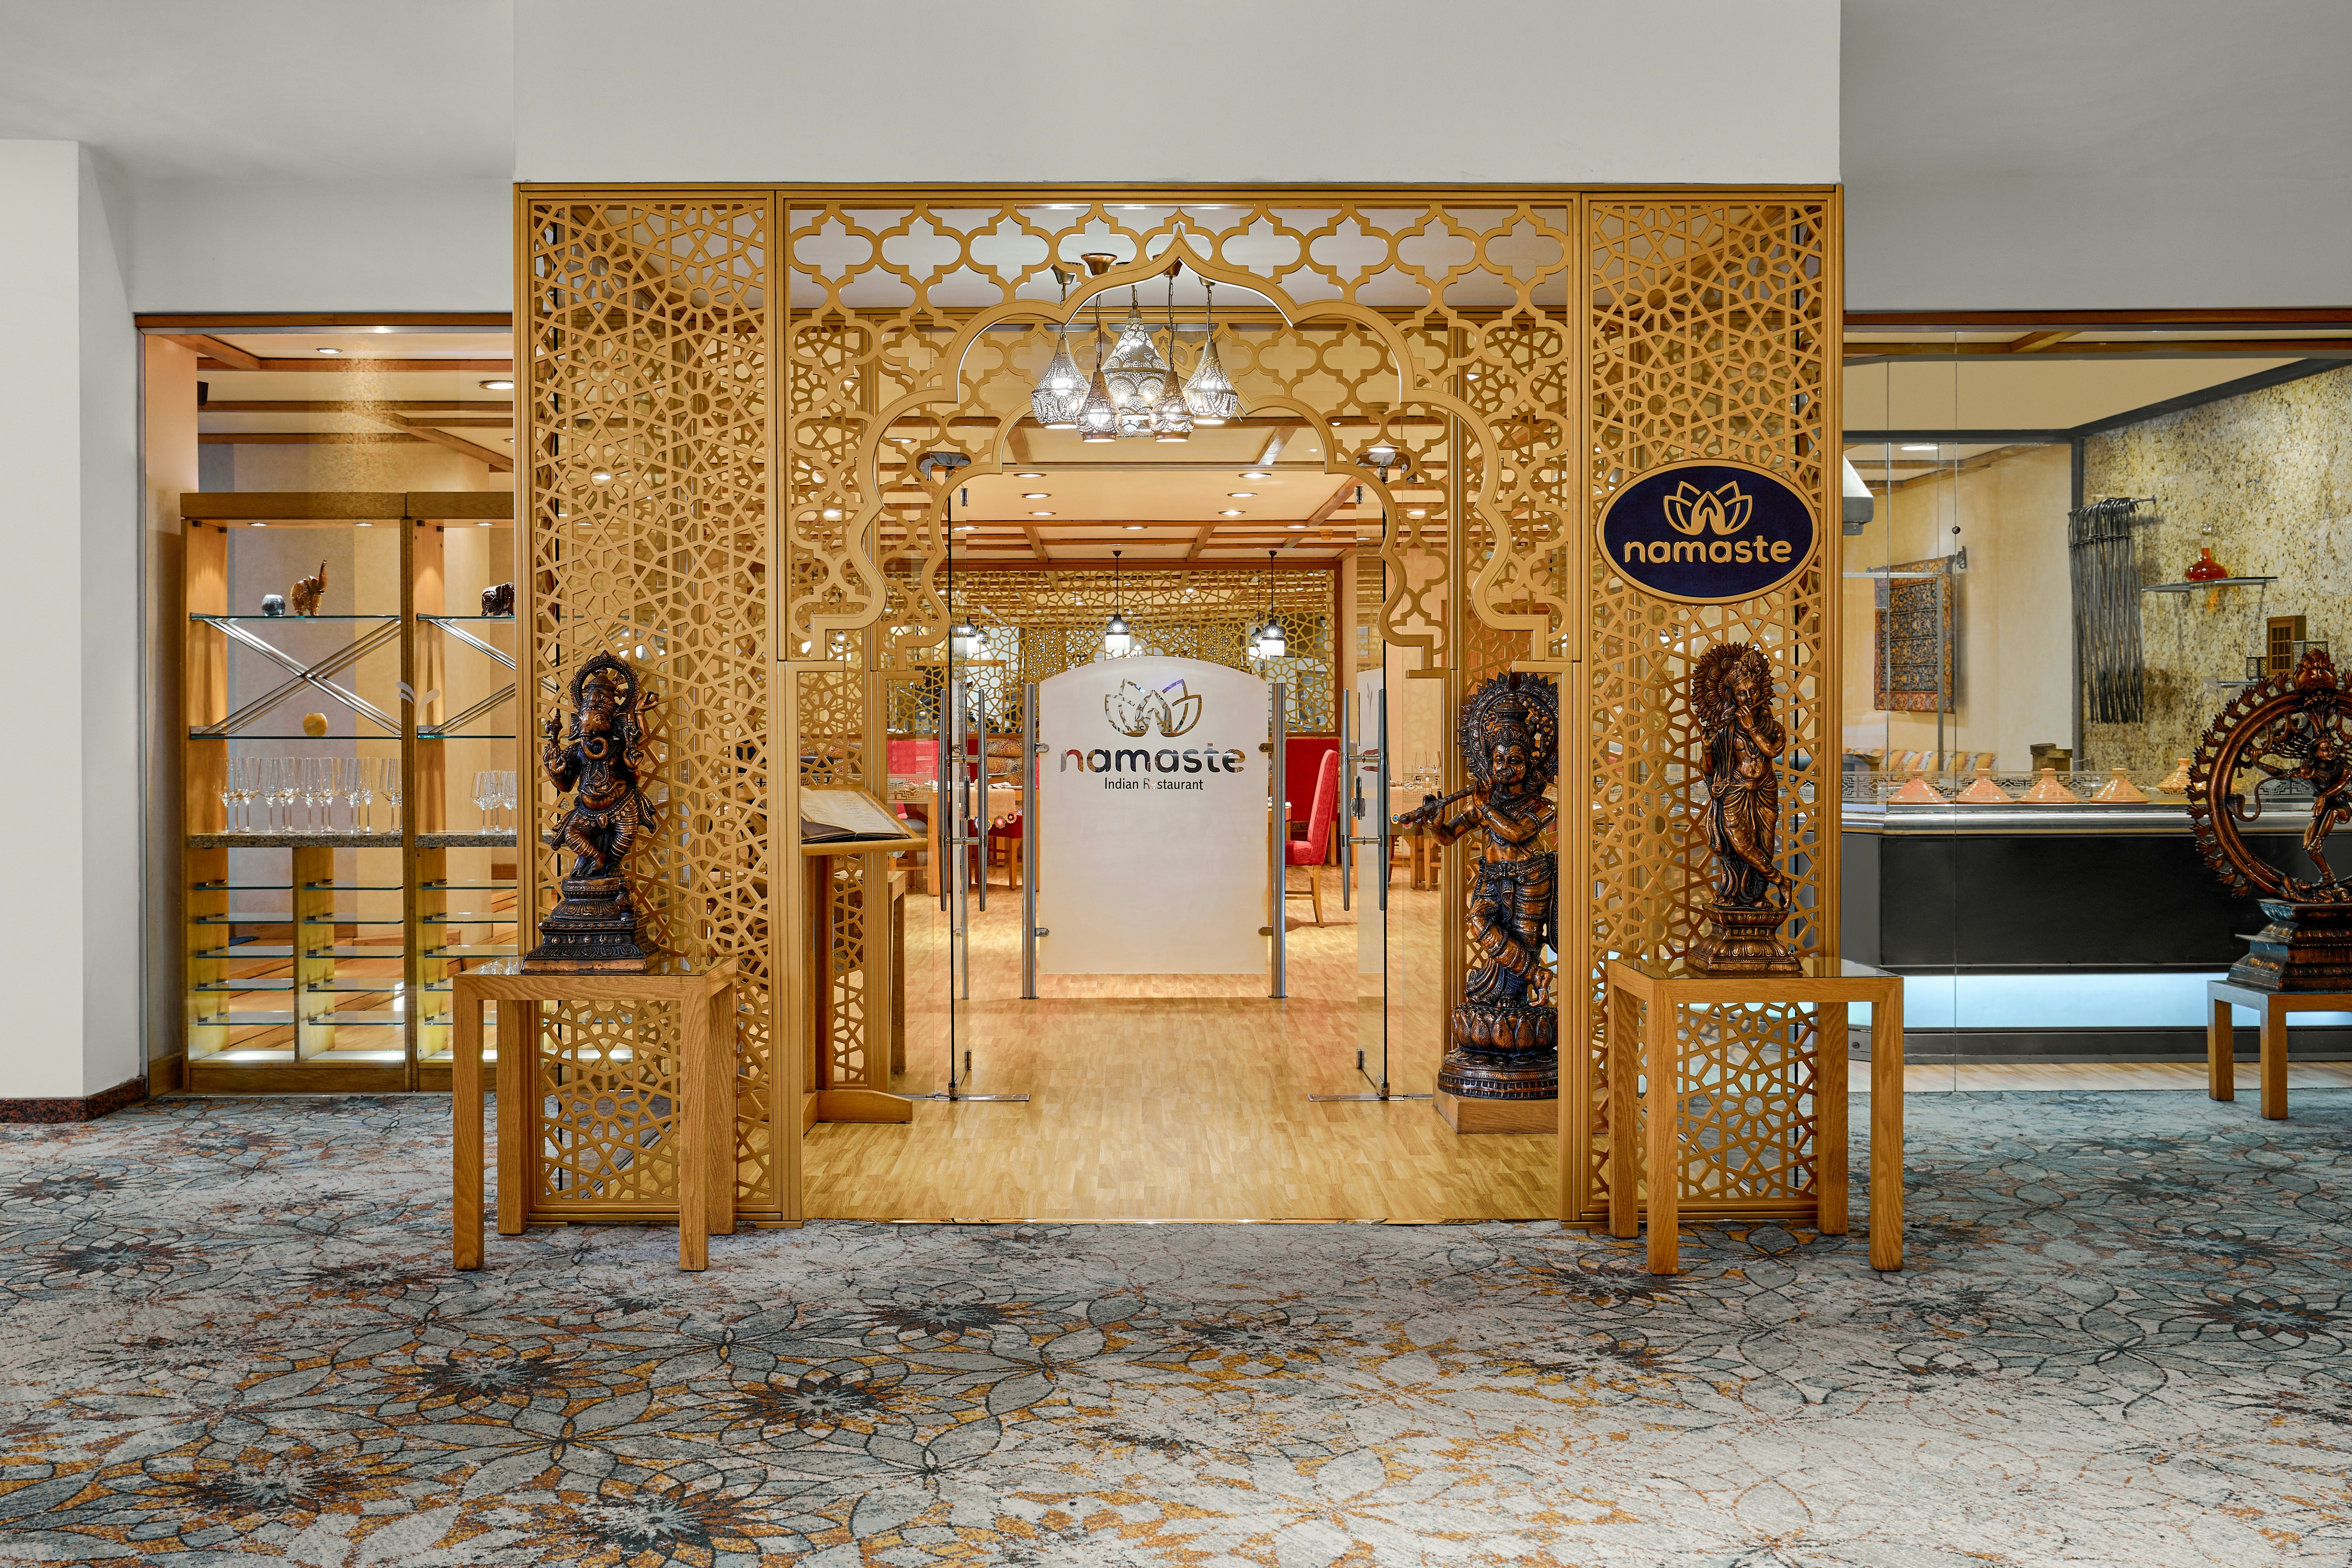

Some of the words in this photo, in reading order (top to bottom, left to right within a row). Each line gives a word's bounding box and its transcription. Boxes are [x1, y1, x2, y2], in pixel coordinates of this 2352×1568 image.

[1624, 536, 1792, 563] namaste
[1060, 743, 1245, 773] namaste
[1105, 777, 1139, 789] Indian
